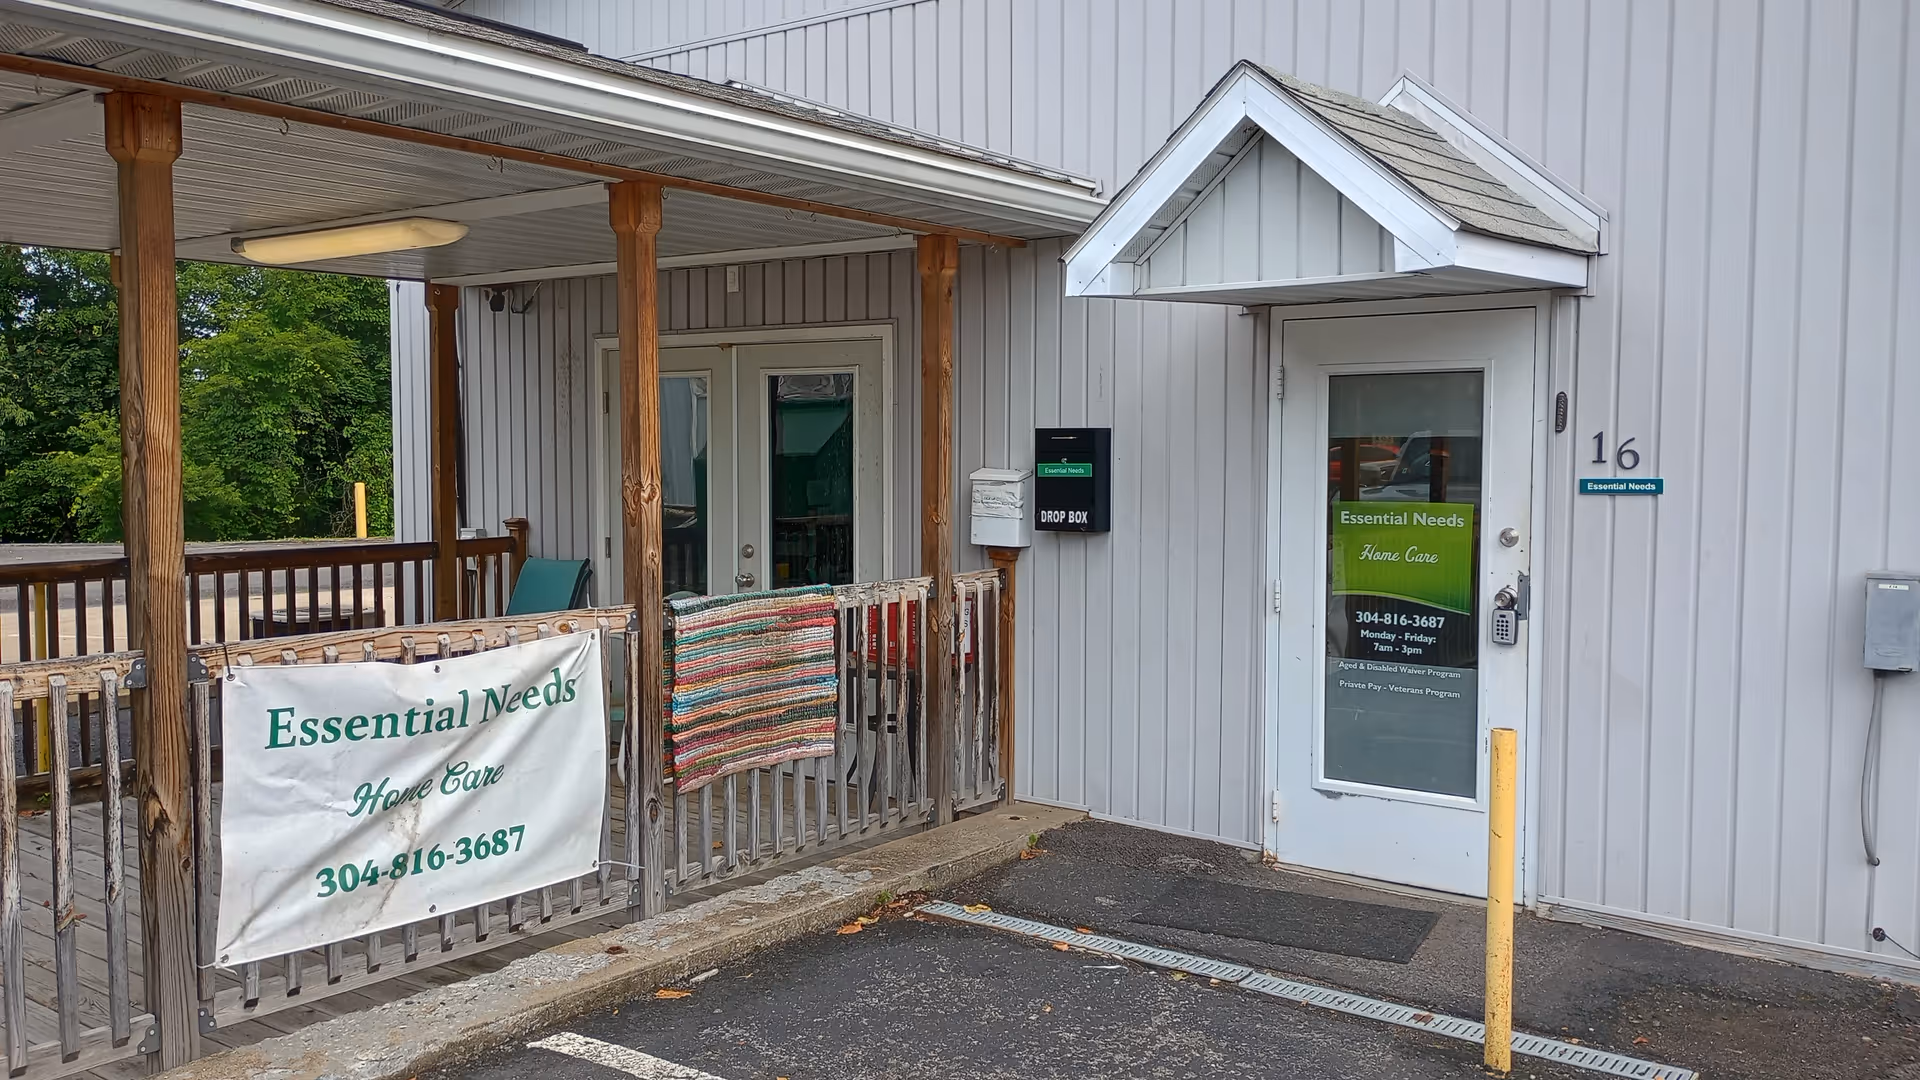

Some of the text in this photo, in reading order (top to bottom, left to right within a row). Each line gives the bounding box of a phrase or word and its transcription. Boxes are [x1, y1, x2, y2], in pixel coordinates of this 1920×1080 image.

[1592, 431, 1640, 470] 16
[1587, 482, 1656, 491] Essential Needs
[1040, 510, 1088, 524] DROP BOX
[1340, 510, 1465, 527] Essential Needs
[1359, 544, 1439, 563] Home Care
[1355, 611, 1445, 629] 304-816-3687
[1360, 629, 1396, 642] Monday
[1404, 632, 1437, 644] Friday:
[1373, 642, 1393, 653] 7am
[1401, 645, 1422, 656] 3pm
[1338, 661, 1358, 670] Aged
[1367, 663, 1398, 673] Disabled
[1399, 666, 1426, 676] Waiver
[1427, 669, 1461, 679] Program
[1368, 682, 1382, 692] Pay
[1388, 684, 1424, 695] Veterans
[1425, 688, 1460, 698] Program
[264, 667, 577, 749] Essential Needs
[346, 760, 505, 818] Home Care
[315, 824, 526, 898] 304-816-3687
